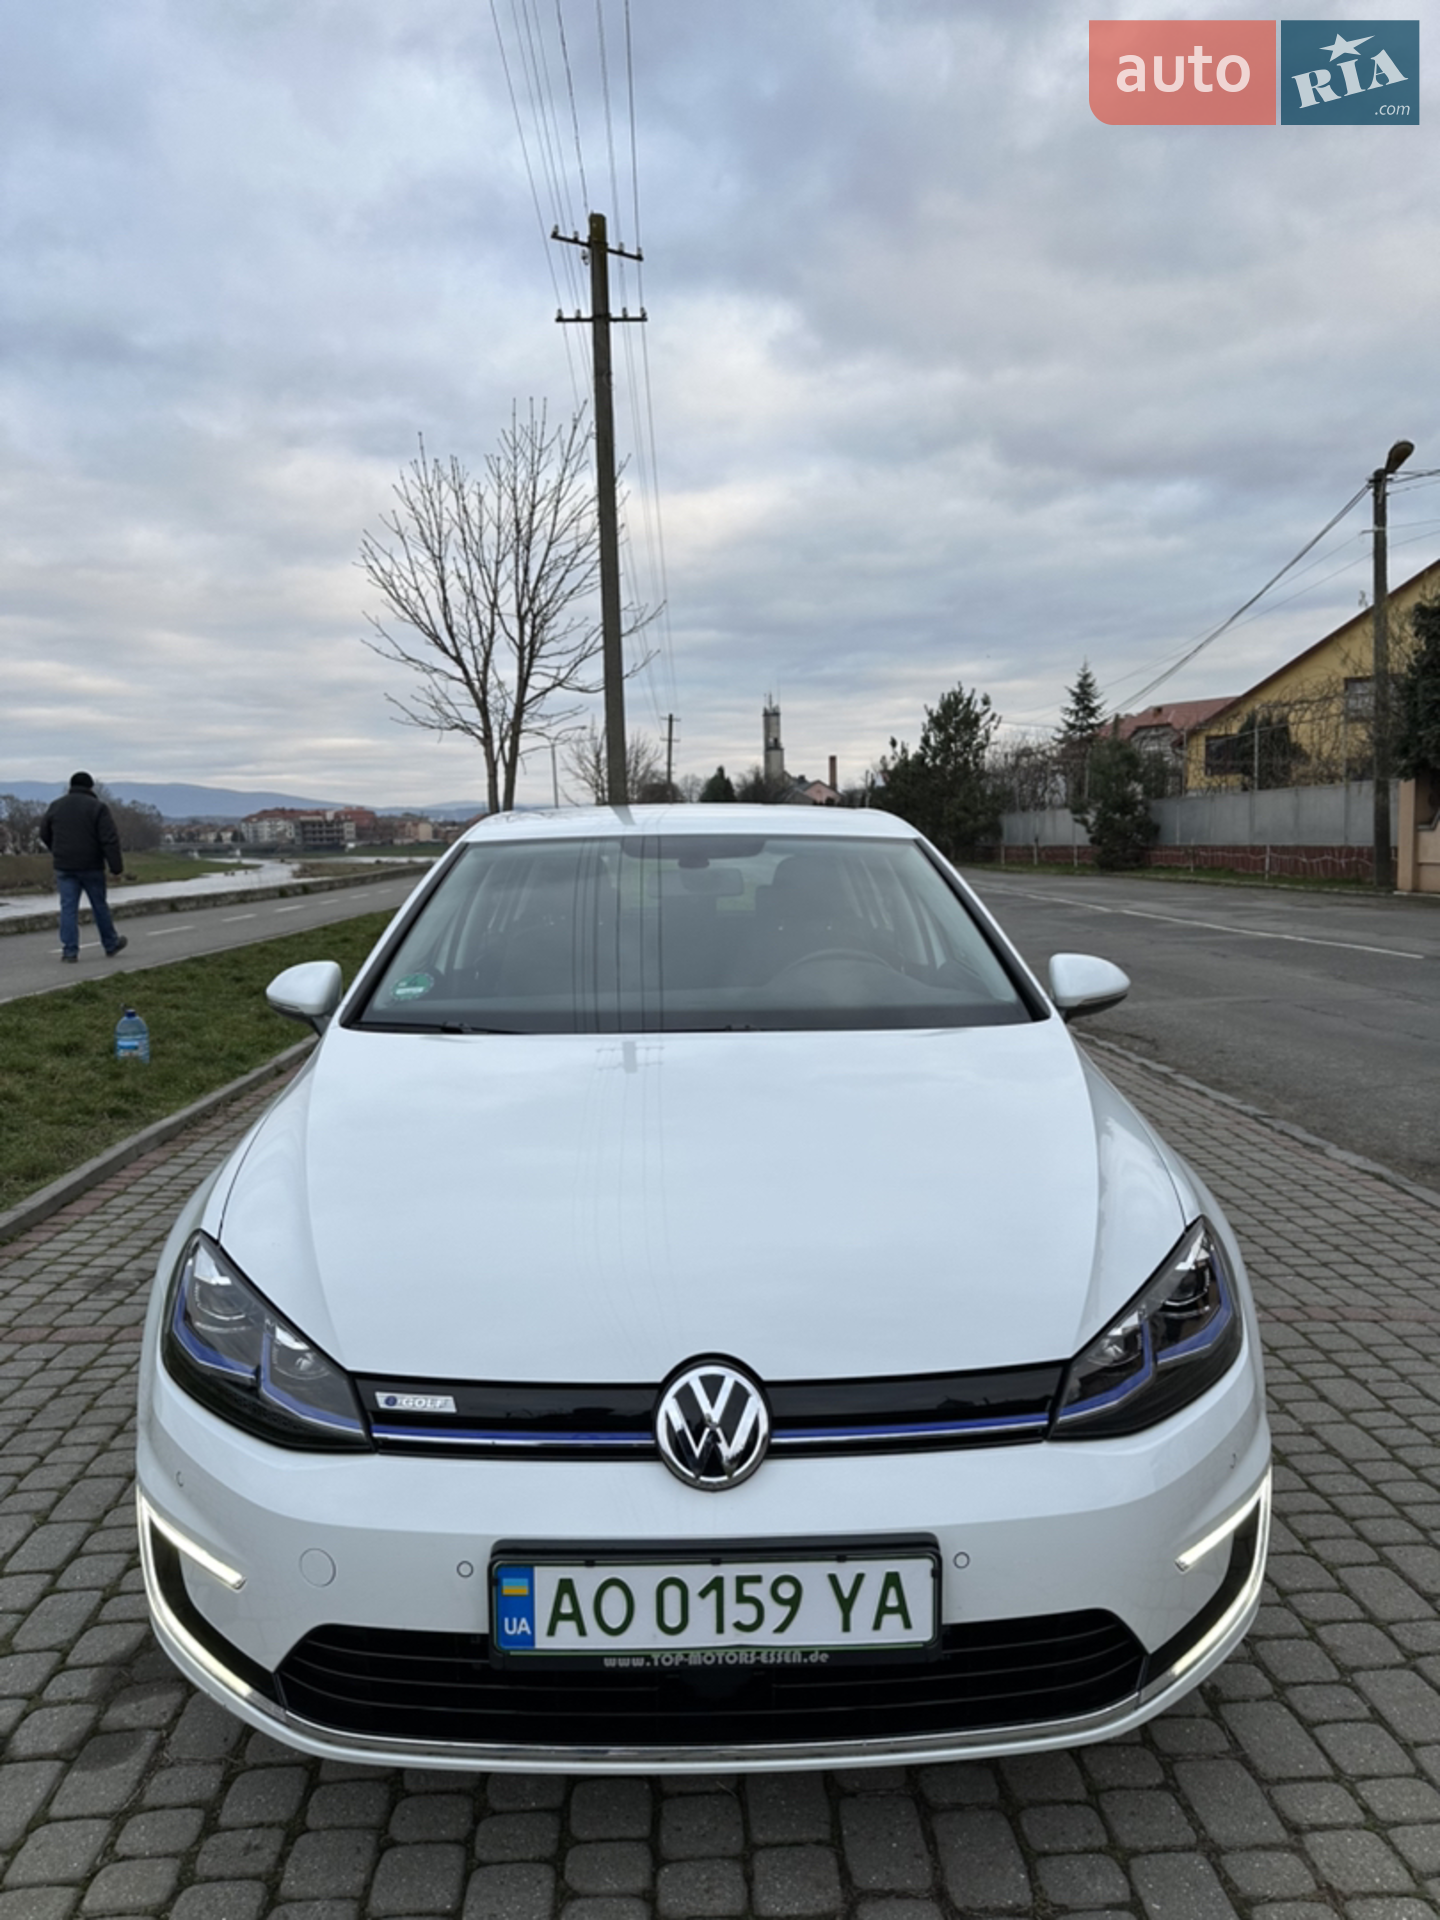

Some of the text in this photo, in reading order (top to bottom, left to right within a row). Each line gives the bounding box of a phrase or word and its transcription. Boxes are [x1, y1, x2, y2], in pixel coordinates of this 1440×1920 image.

[546, 1571, 913, 1638] AO 0159 YA
[504, 1617, 531, 1636] UA
